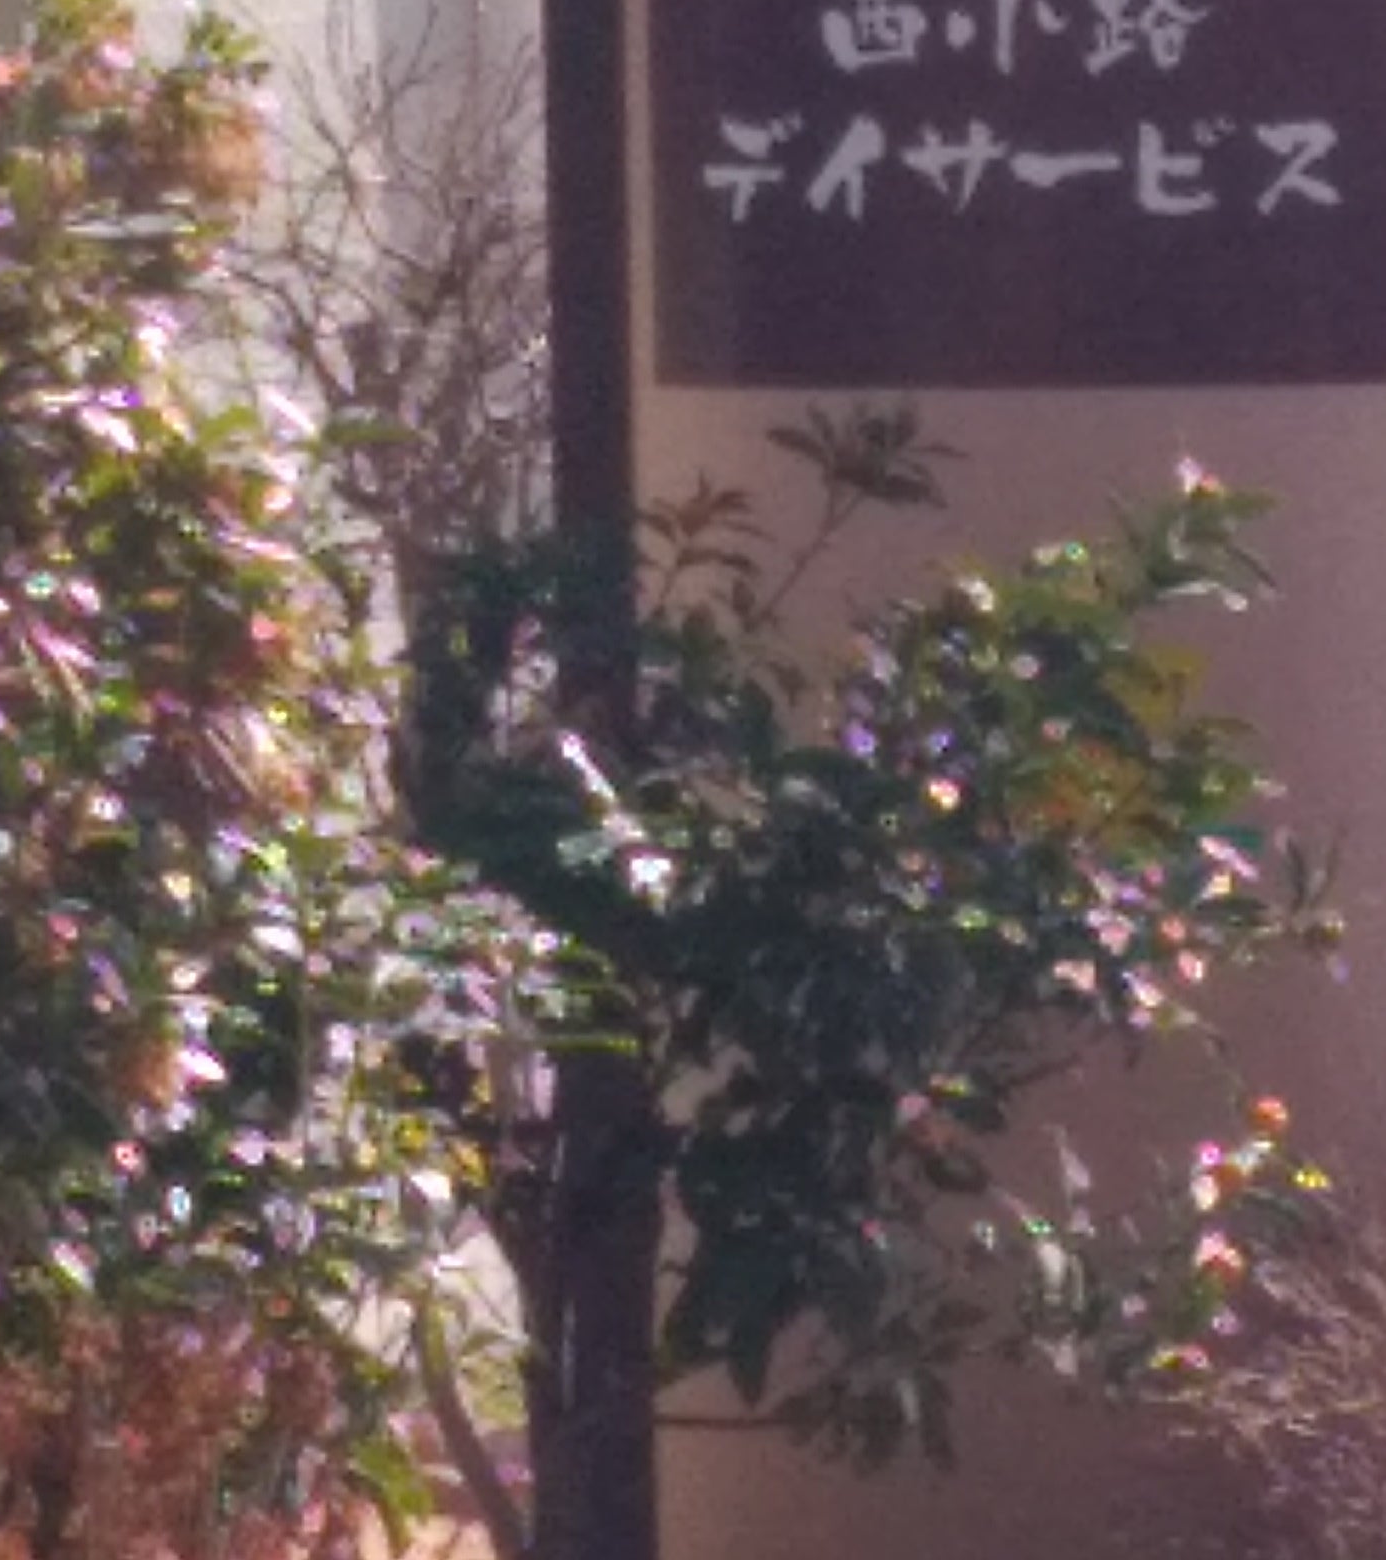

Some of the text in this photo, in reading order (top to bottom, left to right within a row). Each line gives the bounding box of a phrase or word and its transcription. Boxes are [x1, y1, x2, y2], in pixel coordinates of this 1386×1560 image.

[701, 114, 1342, 222] デイサービス
